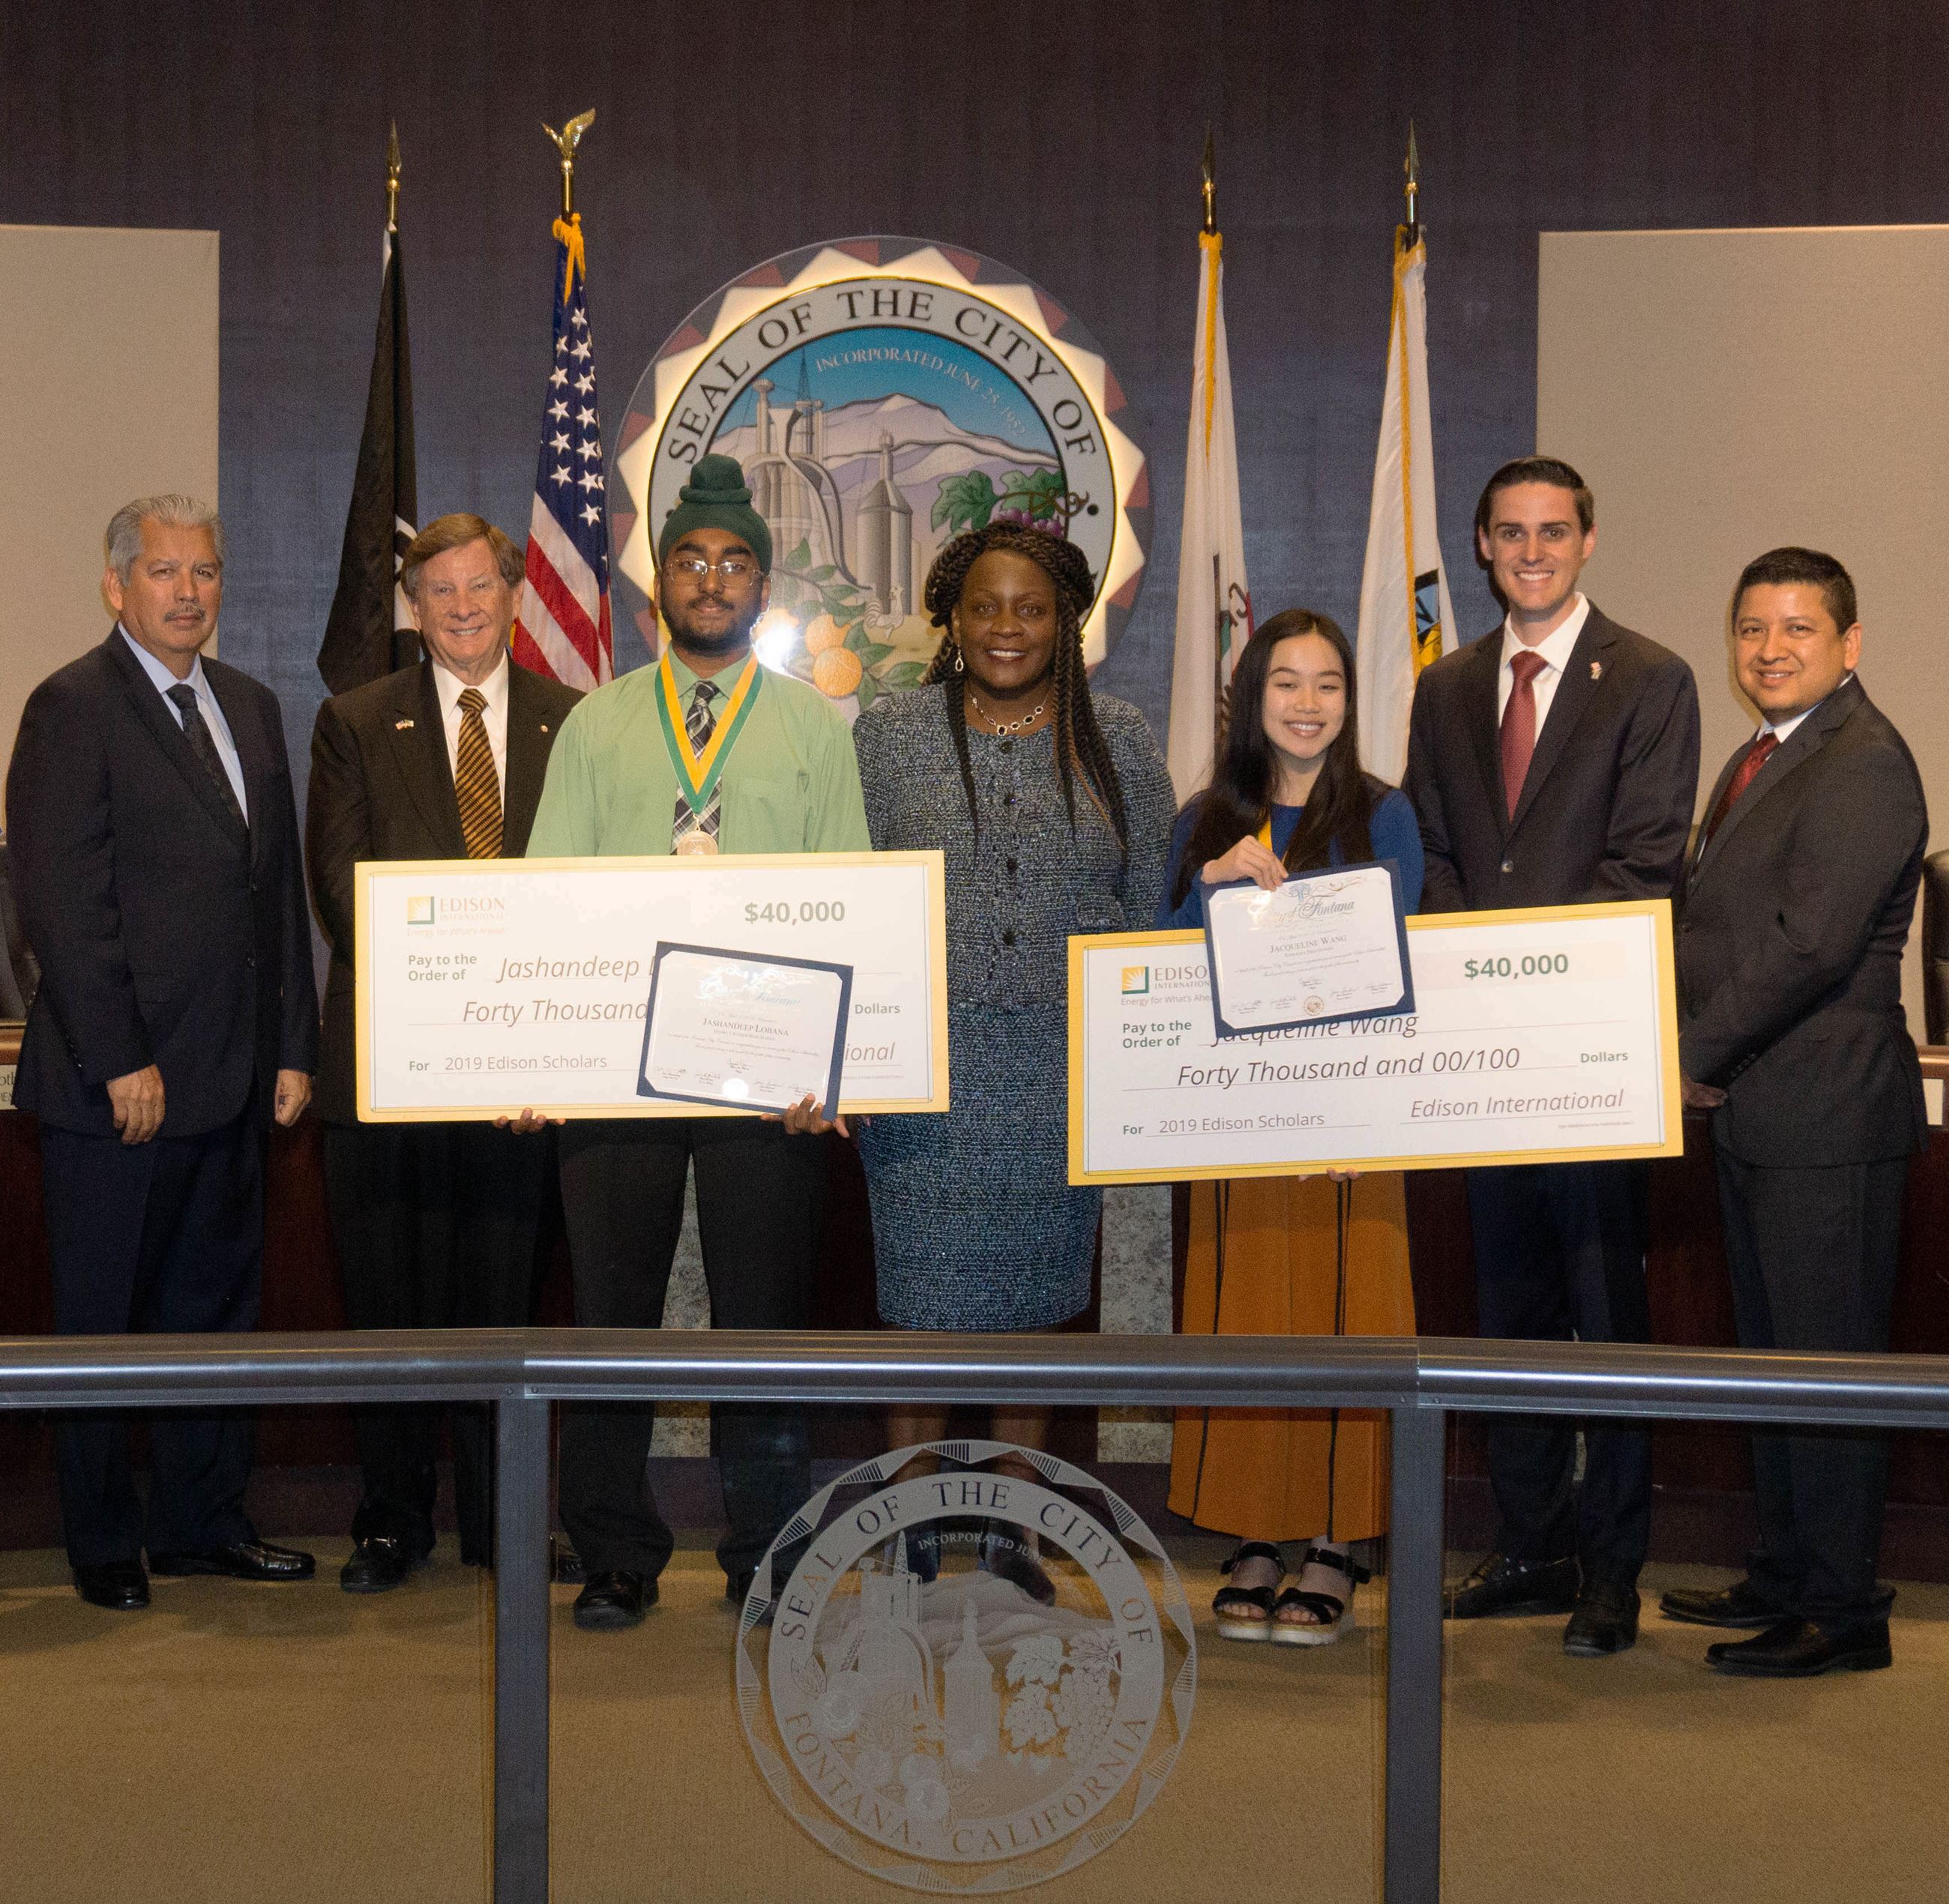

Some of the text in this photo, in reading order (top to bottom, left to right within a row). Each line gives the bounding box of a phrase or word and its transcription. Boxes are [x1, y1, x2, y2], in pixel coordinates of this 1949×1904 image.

[815, 347, 944, 373] INCORPORATED
[668, 289, 1097, 464] SEAL OF THE CITY OF
[440, 897, 505, 912] EDISON
[744, 901, 846, 926] $40,000
[1270, 939, 1319, 953] JACQUELINE
[1320, 935, 1347, 945] WANG
[409, 953, 477, 968] Pay to the
[495, 955, 639, 983] Jashandeep
[1464, 953, 1569, 980] $40,000
[408, 969, 467, 981] Order of
[1155, 965, 1208, 980] EDISO
[1154, 981, 1210, 989] INTERNATION
[855, 1003, 901, 1014] Dollars
[1121, 998, 1148, 1007] Energy
[1151, 996, 1163, 1004] for
[463, 1001, 524, 1028] Forty
[1122, 1020, 1192, 1036] Pay to the
[1211, 1016, 1420, 1048] queine Wang
[844, 1041, 896, 1061] ional
[1122, 1034, 1181, 1049] Order of
[409, 1055, 607, 1071] For 2019 Edison Scholars
[1178, 1048, 1628, 1090] Forty Thousand and 00/100 Dollars
[1411, 1088, 1624, 1118] Edison International
[1122, 1112, 1325, 1135] For 2019 Edison Scholars
[918, 1532, 1015, 1550] INCORPORATED
[780, 1480, 1154, 1643] SEAL OF THE CITY OF
[951, 1720, 1148, 1855] CALIFORNIA
